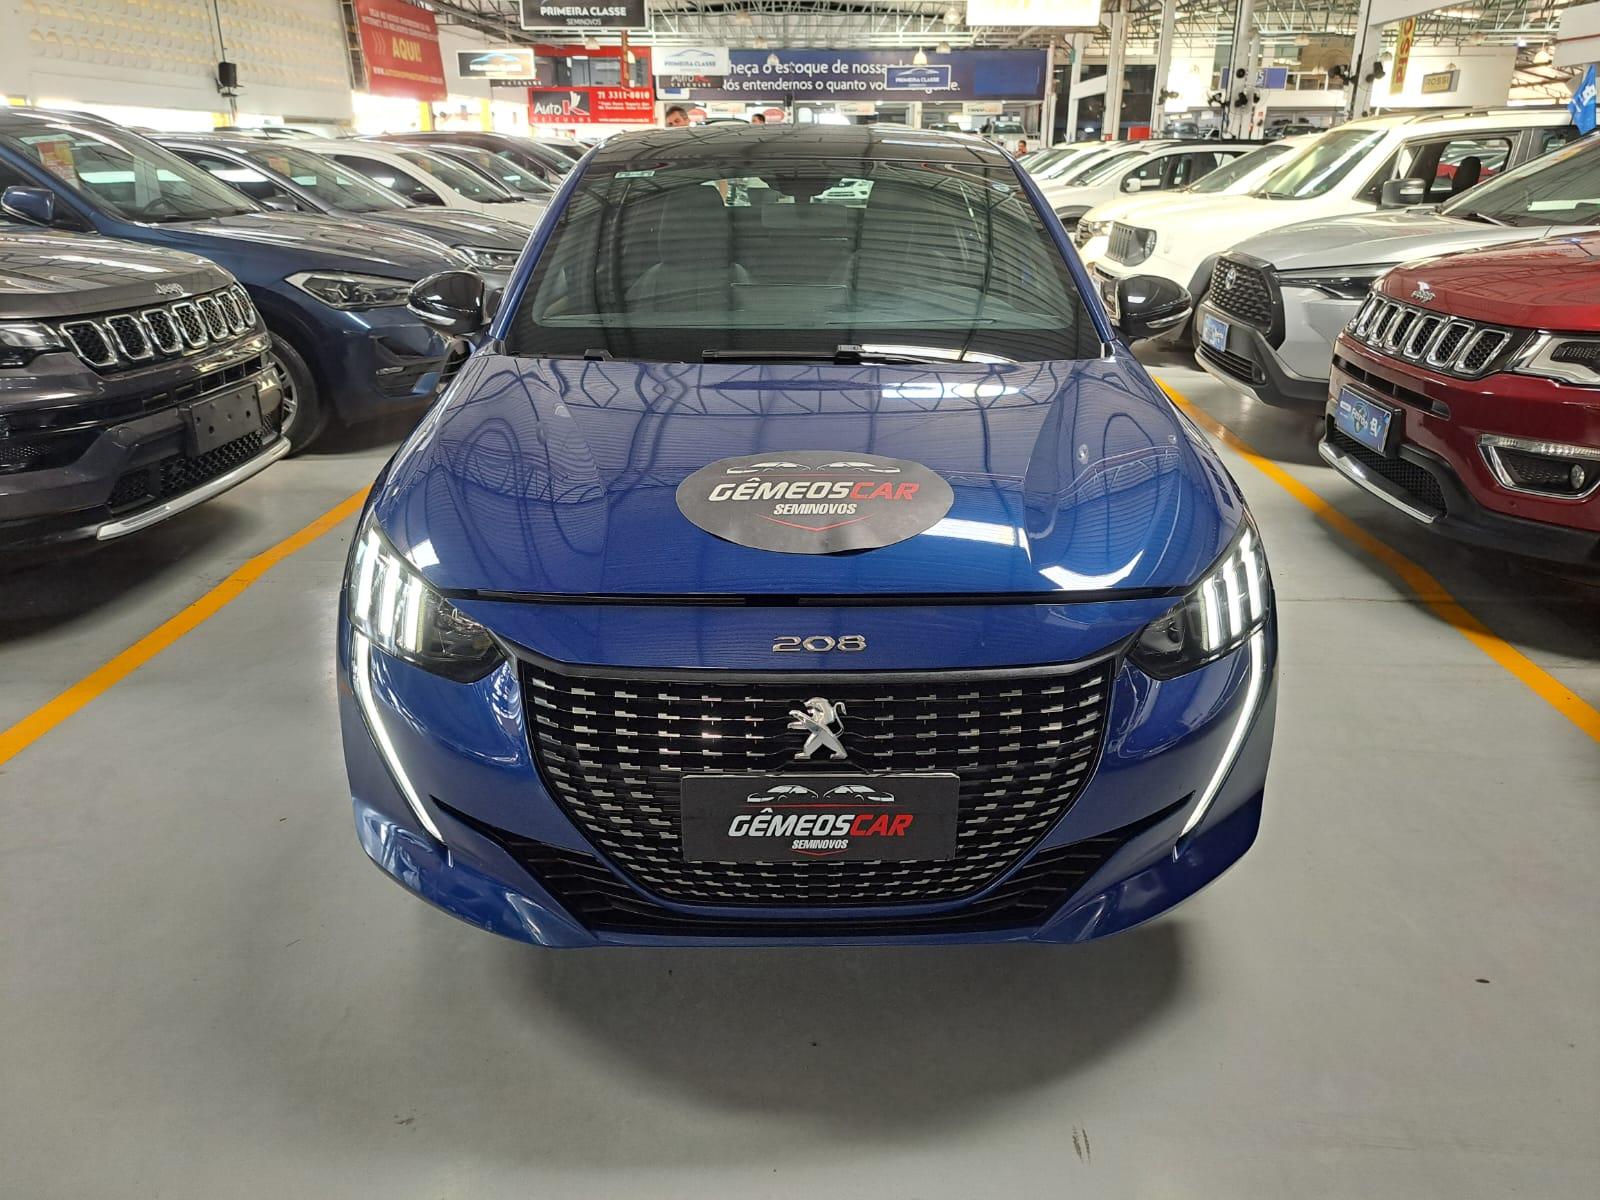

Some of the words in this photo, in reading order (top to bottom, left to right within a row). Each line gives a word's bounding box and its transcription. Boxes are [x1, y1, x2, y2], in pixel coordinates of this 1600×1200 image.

[540, 6, 589, 16] PRIMEIRA
[590, 6, 627, 16] CLASSE
[762, 63, 772, 74] o
[775, 62, 829, 78] estoque
[832, 59, 849, 74] de
[852, 62, 887, 74] nossa
[742, 79, 813, 91] entendemos
[815, 82, 824, 91] o
[826, 80, 867, 93] quanto
[534, 101, 562, 116] Auto
[709, 477, 920, 502] GÊMEOSCAR
[773, 503, 857, 515] SEMINOVOS
[772, 635, 867, 652] 208
[728, 808, 914, 837] GÊMEOSCAR
[791, 839, 848, 850] SEMINOVOS
